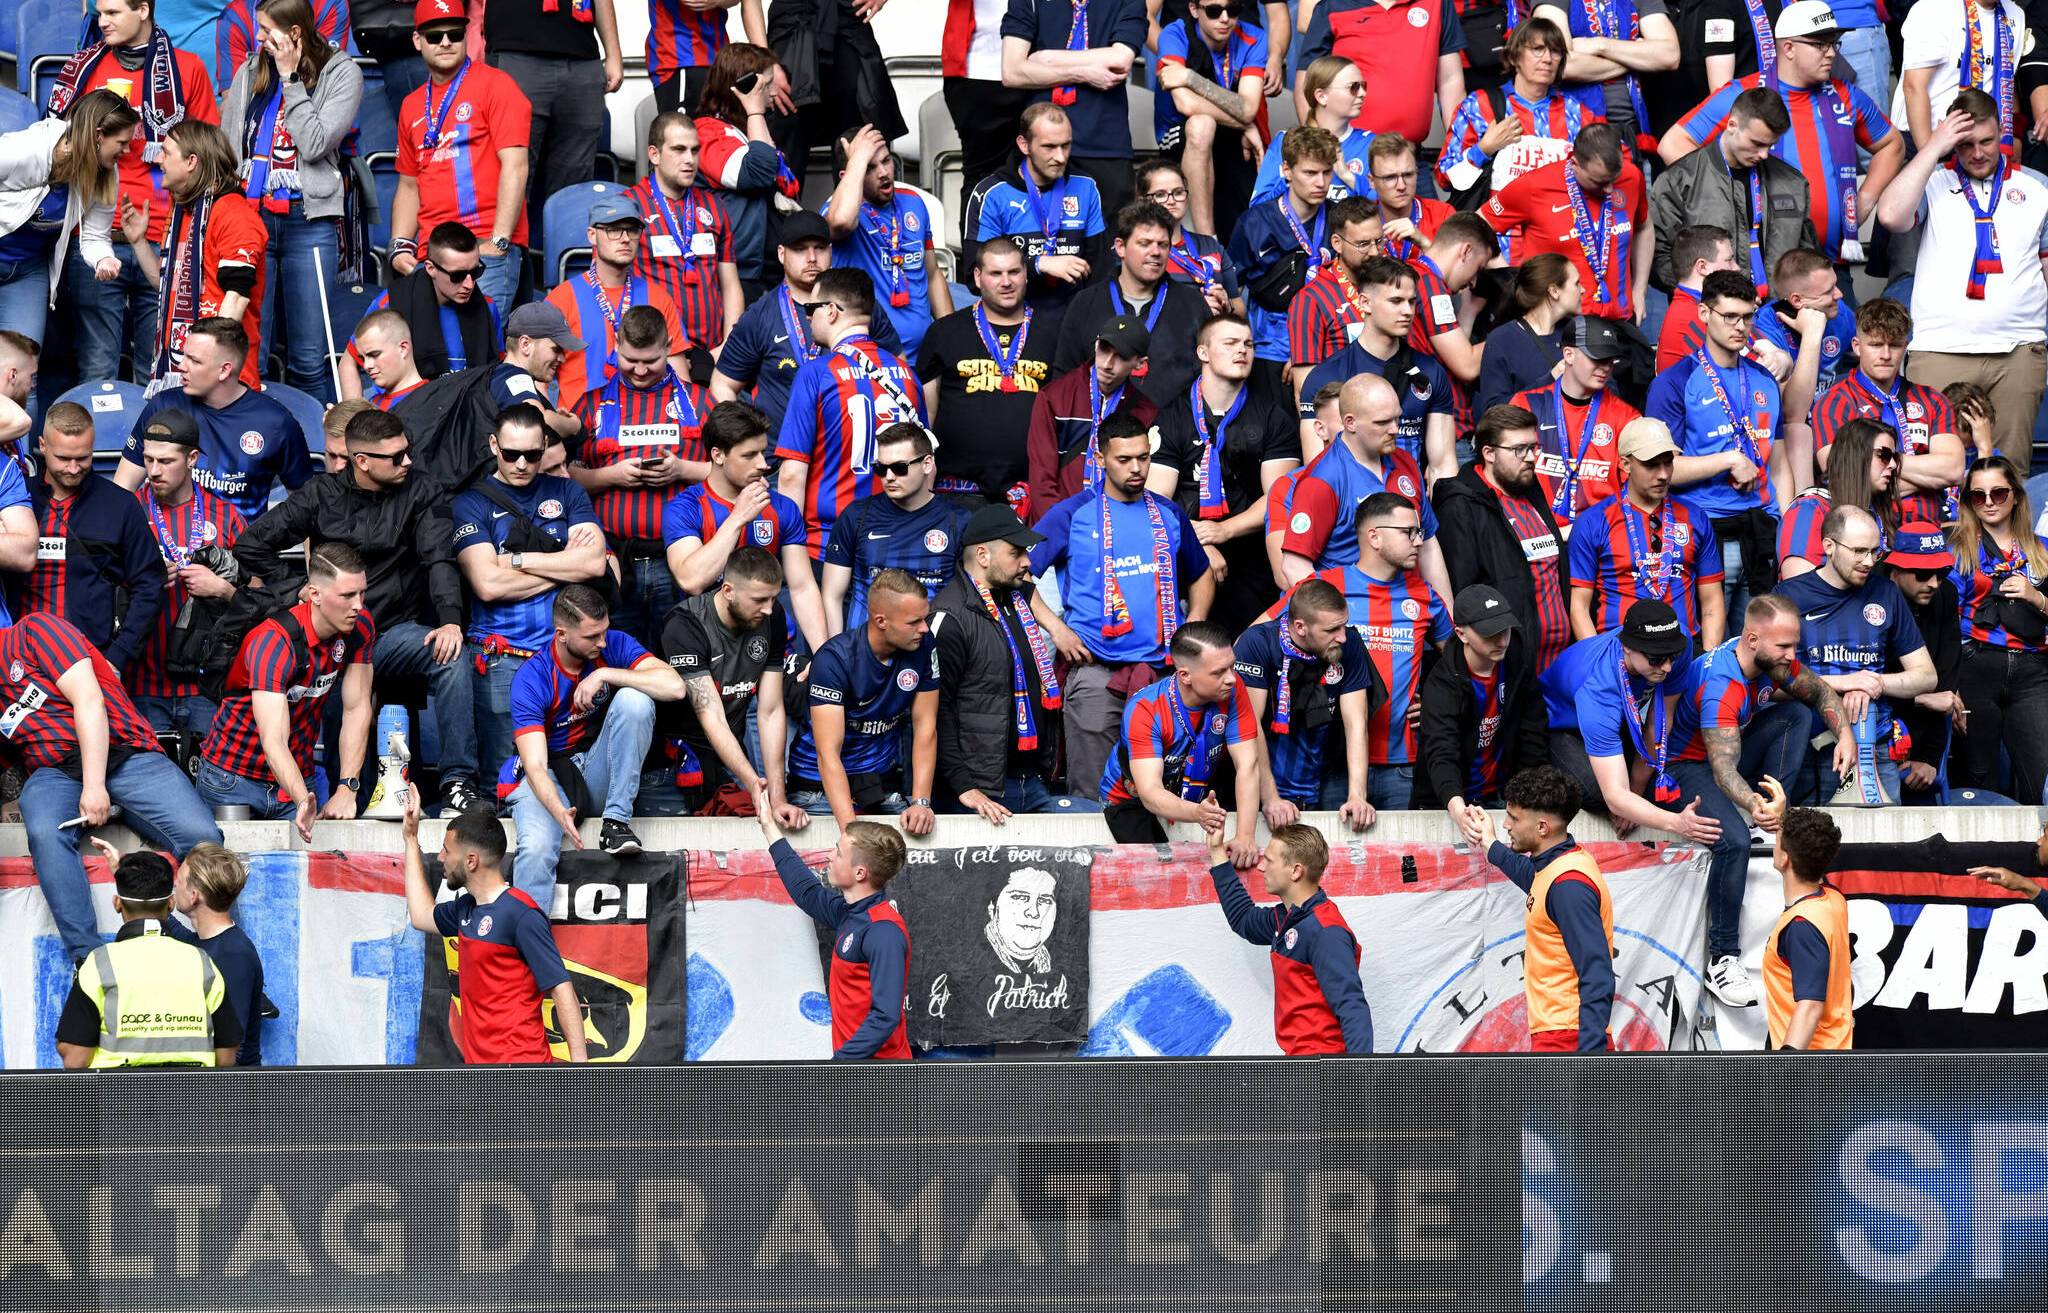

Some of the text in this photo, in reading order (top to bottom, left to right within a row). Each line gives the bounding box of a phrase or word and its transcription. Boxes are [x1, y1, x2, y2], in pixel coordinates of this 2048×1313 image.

[1382, 626, 1414, 639] BUHTZ
[1823, 644, 1879, 665] Bitburger
[811, 686, 840, 700] HAKO
[986, 973, 1071, 1019] Patrick
[121, 1012, 203, 1024] pape & Grunau
[121, 1025, 148, 1033] security
[151, 1024, 164, 1032] und
[459, 1178, 708, 1275] DER
[751, 1170, 1458, 1270] AMATEURE
